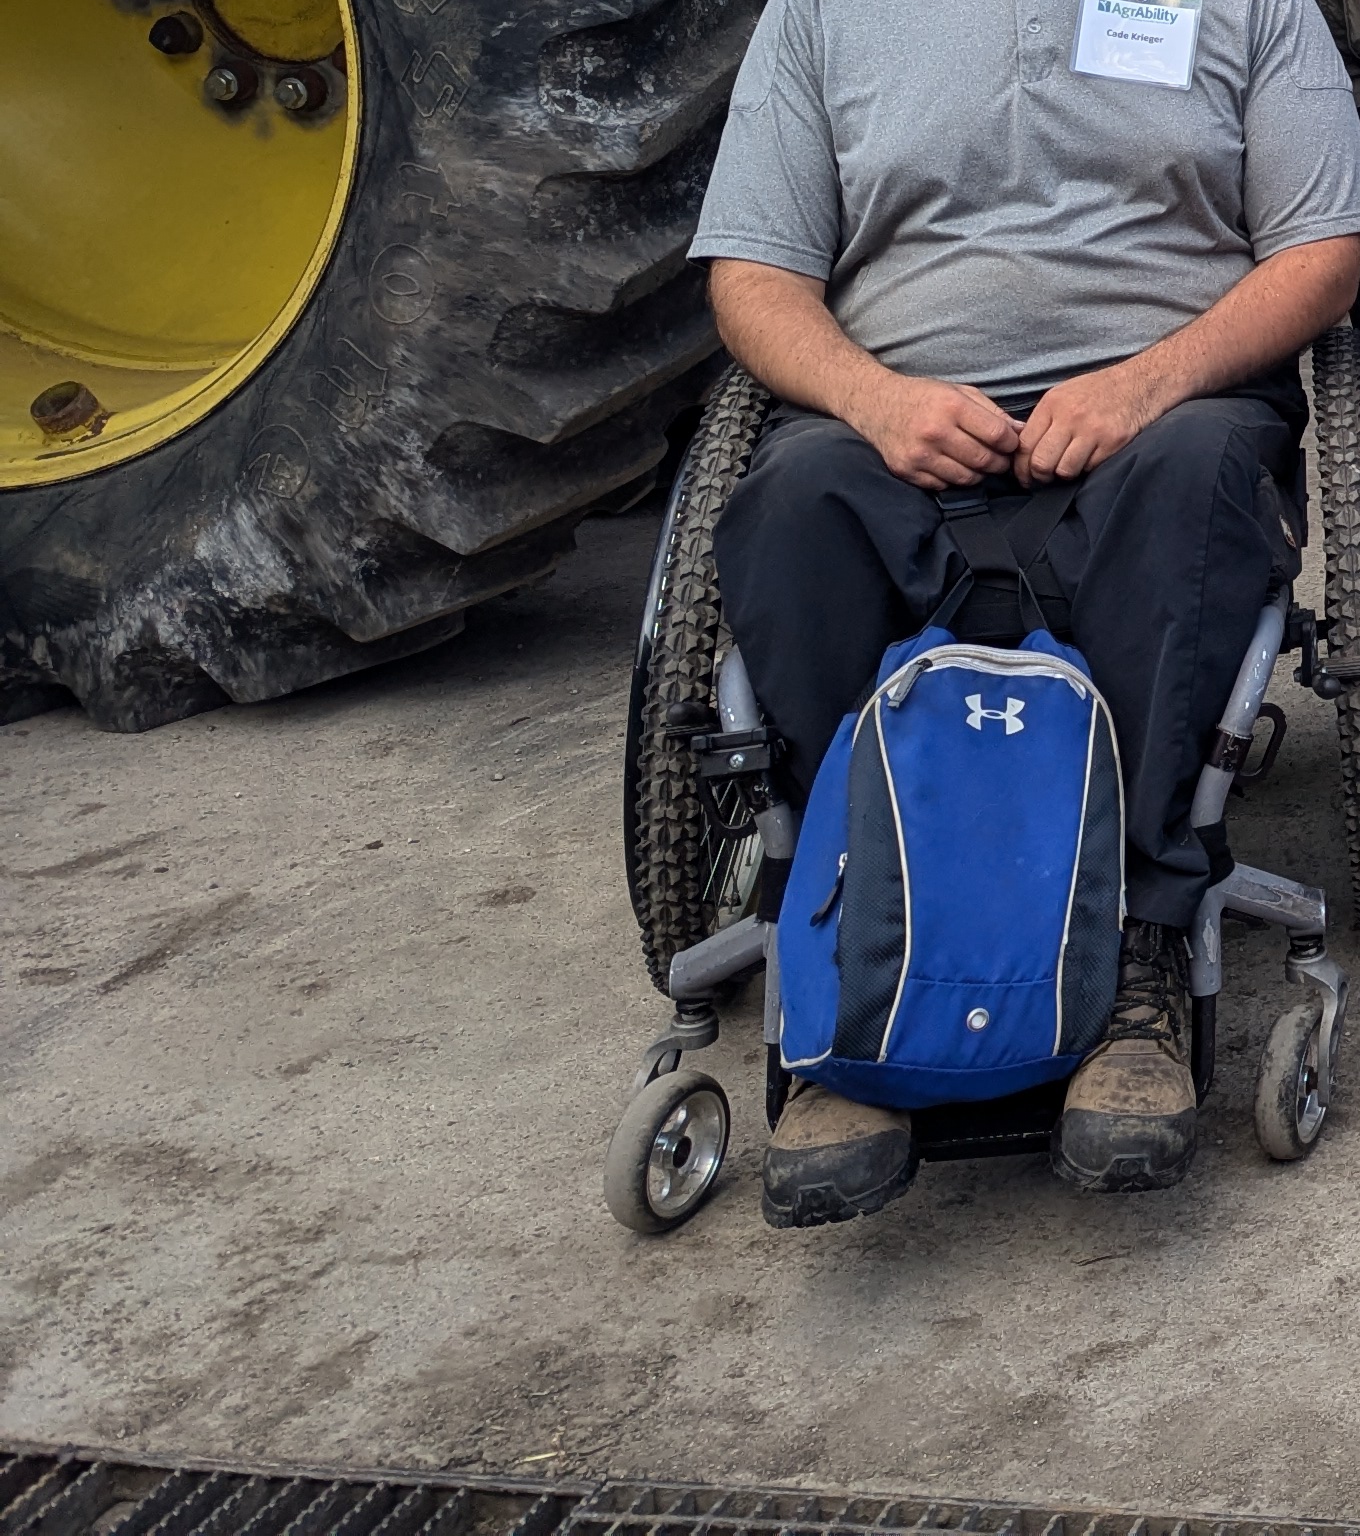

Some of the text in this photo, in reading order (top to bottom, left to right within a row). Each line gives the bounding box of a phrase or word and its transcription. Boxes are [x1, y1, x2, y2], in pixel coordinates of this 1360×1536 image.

[1111, 2, 1179, 25] AgrAbility
[1106, 28, 1165, 44] Cade Krieger
